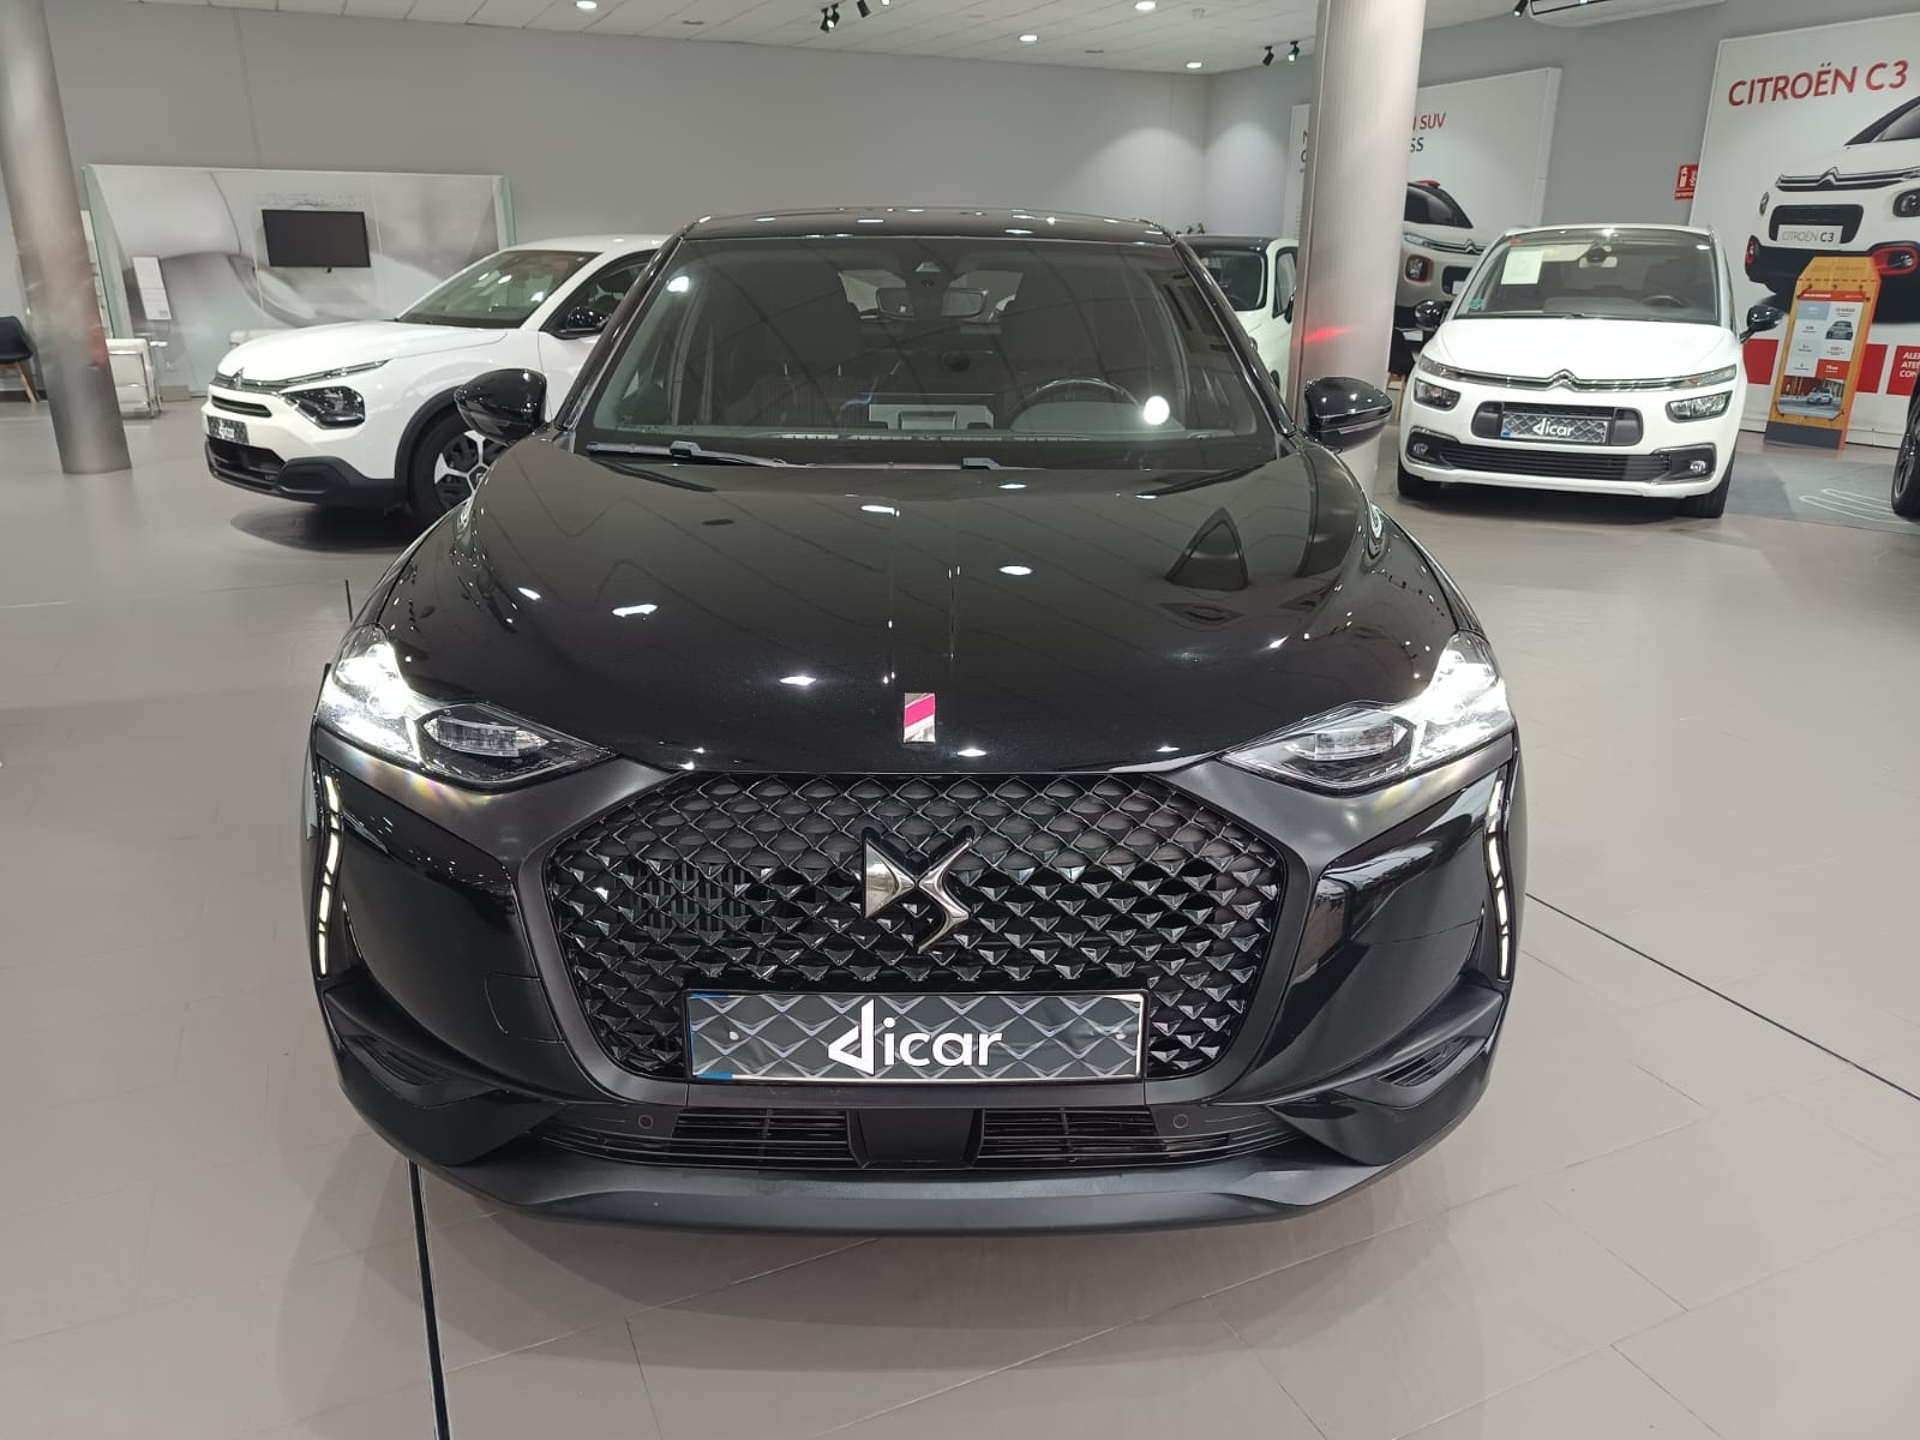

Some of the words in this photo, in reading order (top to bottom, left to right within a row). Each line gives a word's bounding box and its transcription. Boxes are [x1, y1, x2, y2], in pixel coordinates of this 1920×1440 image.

[1728, 61, 1858, 106] CITROËN
[1865, 59, 1909, 91] C3
[1419, 112, 1447, 130] SUV
[1820, 231, 1835, 242] C3
[1532, 417, 1575, 437] dicar
[827, 998, 1003, 1076] dicar
